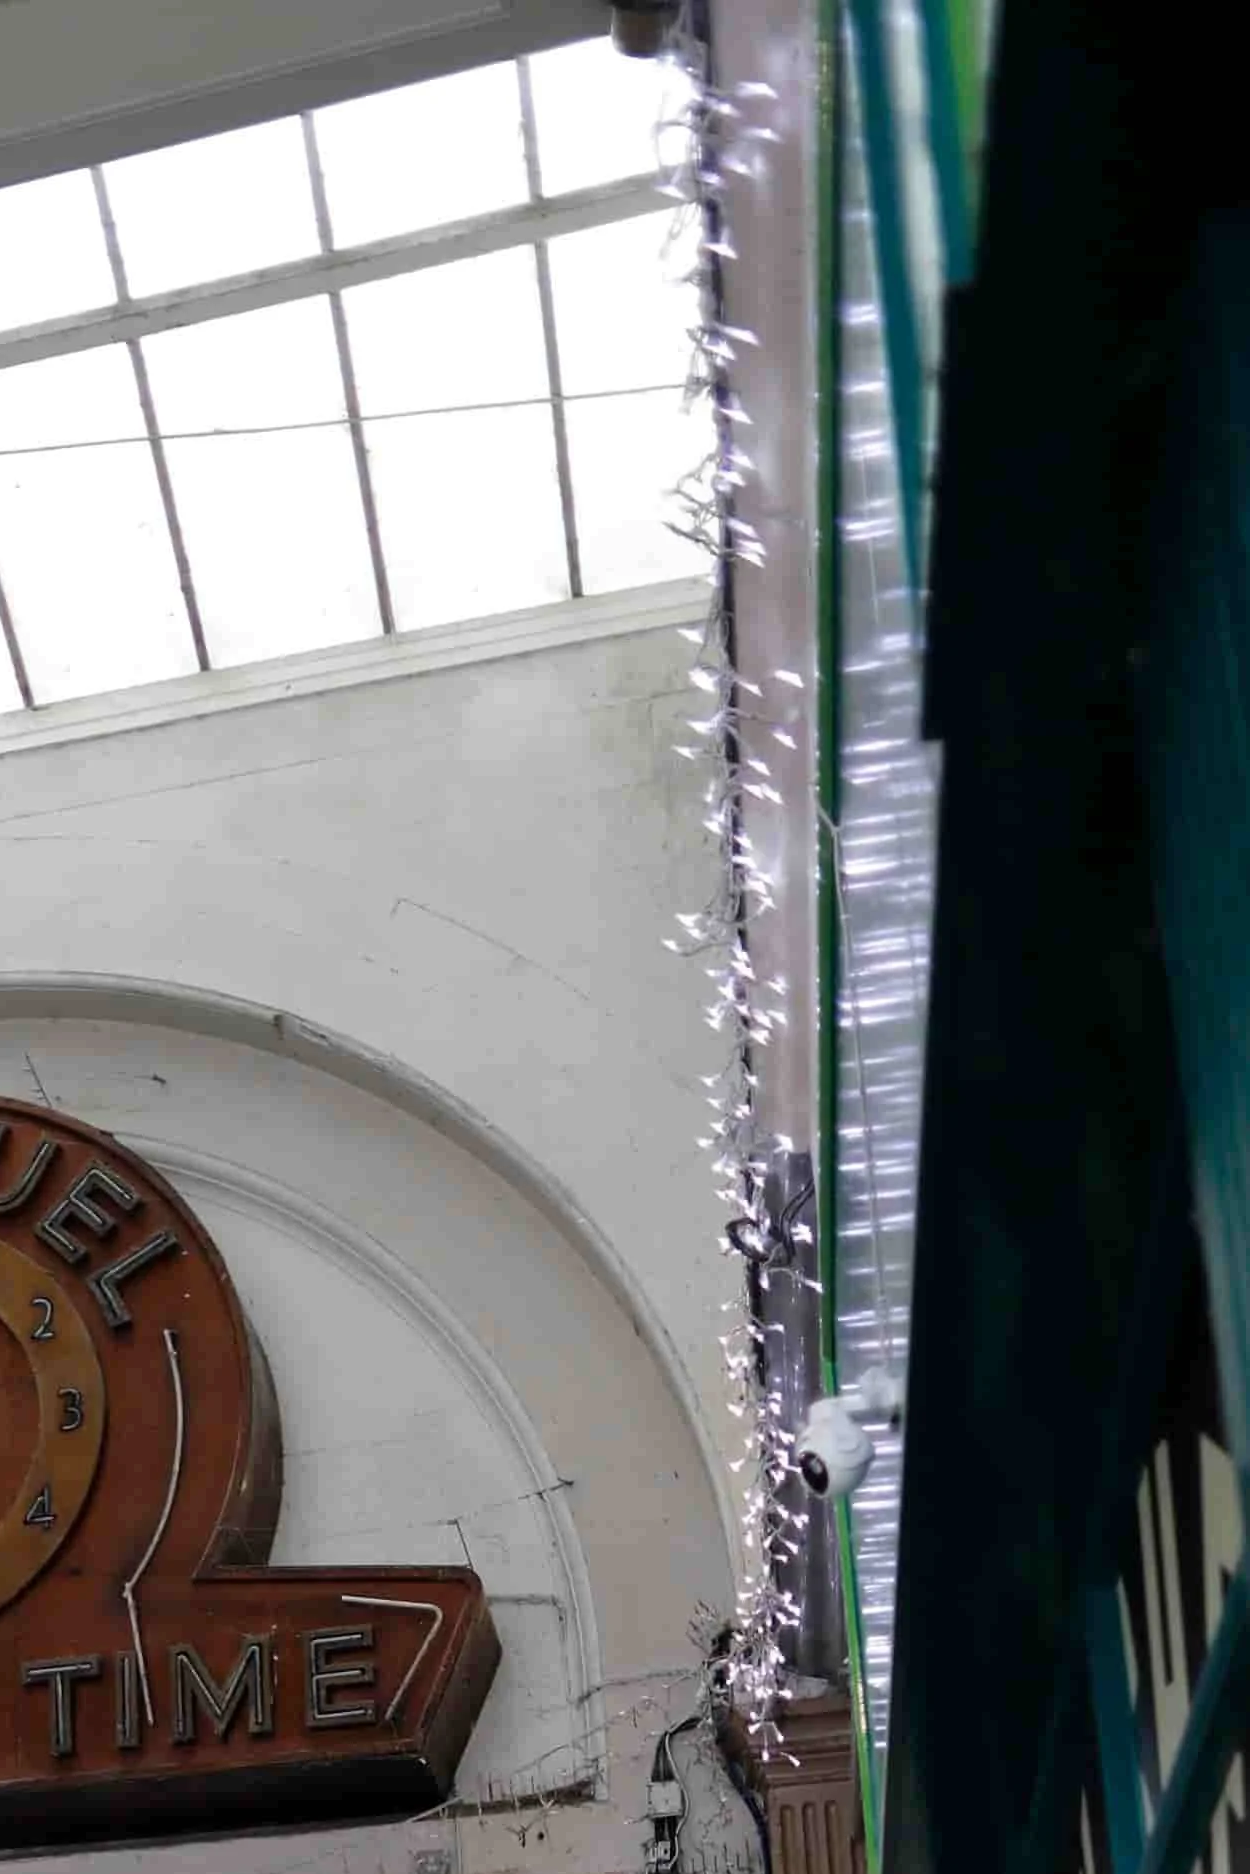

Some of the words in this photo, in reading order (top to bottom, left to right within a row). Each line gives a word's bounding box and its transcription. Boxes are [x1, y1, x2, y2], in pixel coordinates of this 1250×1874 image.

[31, 1297, 55, 1340] 2
[56, 1388, 83, 1431] 3
[22, 1487, 56, 1529] 4
[21, 1622, 377, 1758] TIME
